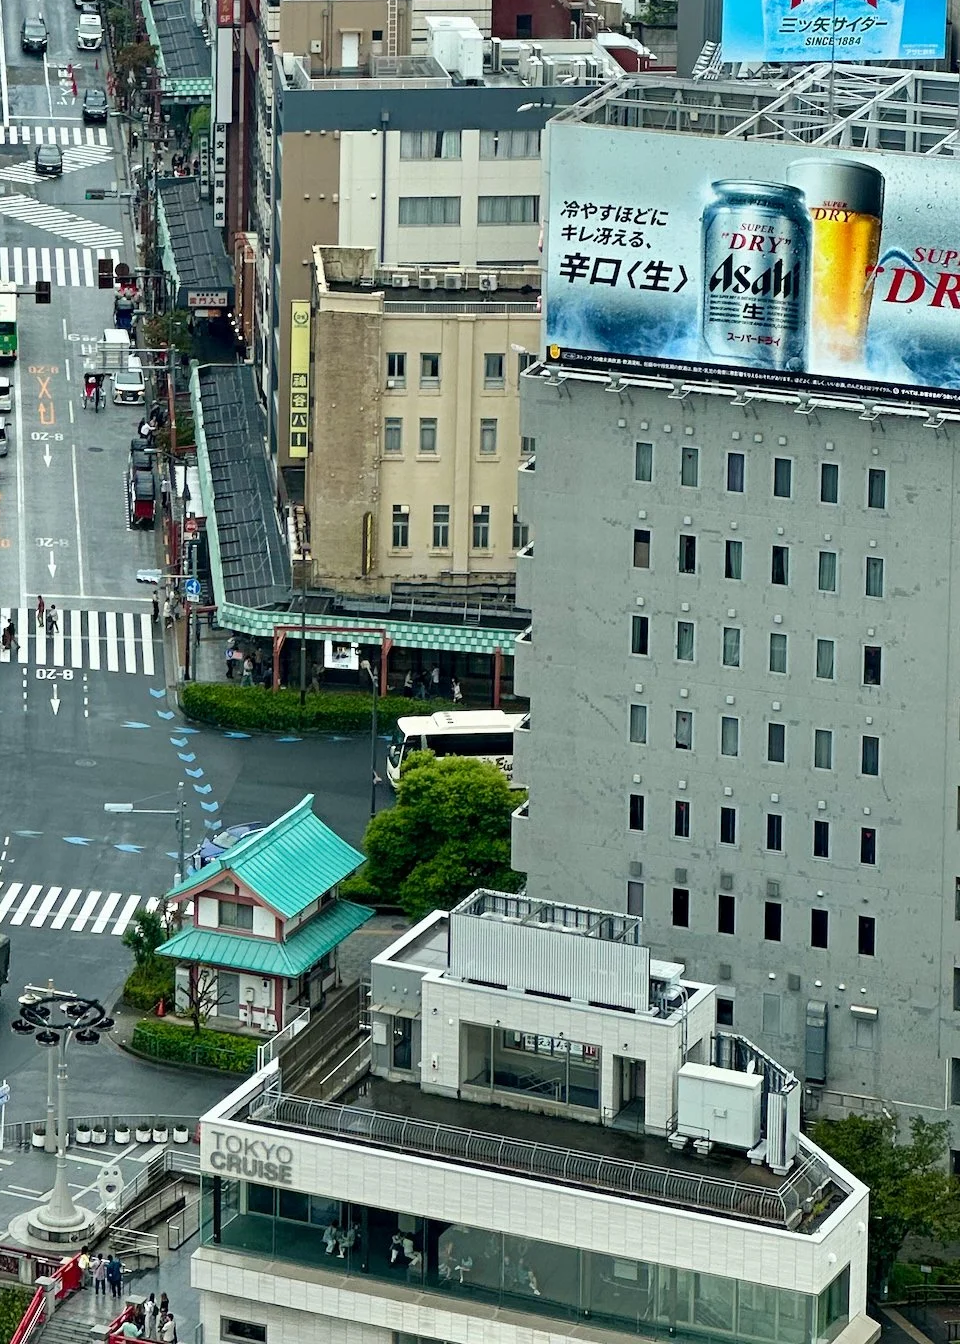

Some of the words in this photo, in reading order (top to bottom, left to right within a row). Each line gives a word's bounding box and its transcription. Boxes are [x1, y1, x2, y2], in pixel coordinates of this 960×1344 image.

[778, 16, 888, 33] 三ツ矢サイダー
[805, 37, 834, 46] SINCE
[838, 36, 861, 46] 1884
[559, 200, 670, 227] 冷やすほどに
[823, 200, 848, 209] SUPER
[559, 224, 652, 250] キレ冴える、
[740, 223, 775, 234] SUPER
[912, 246, 960, 267] SUP
[708, 253, 801, 301] Asahi
[742, 303, 766, 321] 生
[727, 332, 781, 347] スーパードライ
[292, 373, 308, 447] 神谷バー
[31, 431, 64, 441] 8-20
[35, 668, 74, 681] 8-20
[211, 1130, 293, 1164] TOKYO
[209, 1151, 293, 1185] CRUISE
